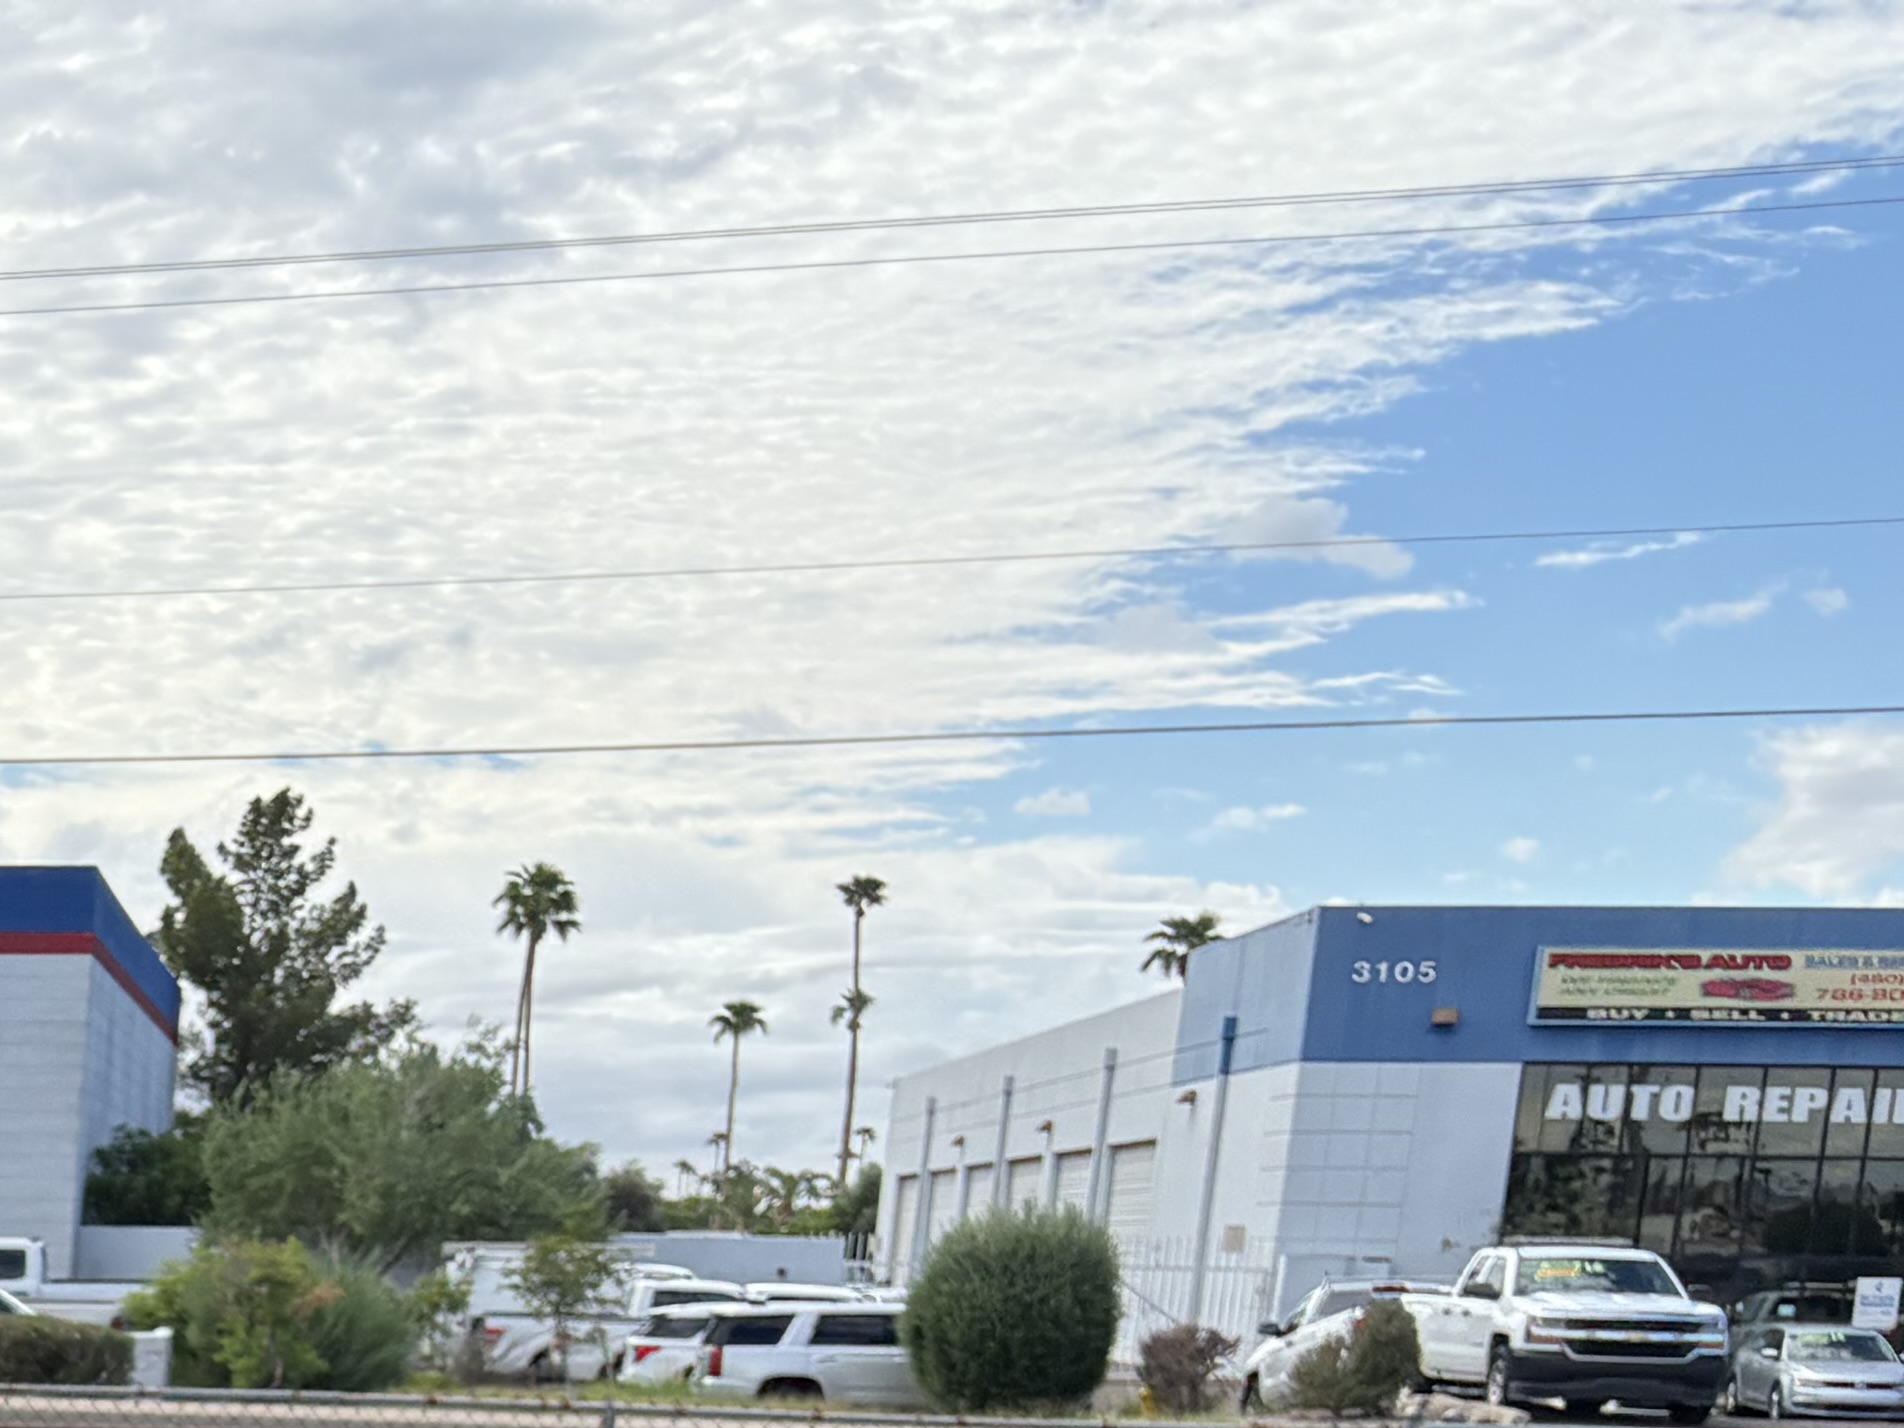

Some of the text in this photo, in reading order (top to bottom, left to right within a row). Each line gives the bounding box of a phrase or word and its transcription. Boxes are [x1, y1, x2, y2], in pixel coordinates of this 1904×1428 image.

[1703, 954, 1792, 971] AUTO
[1352, 960, 1437, 984] 3105
[1586, 1008, 1649, 1020] BUY
[1690, 1009, 1766, 1021] SELL
[1543, 1082, 1695, 1121] AUTO
